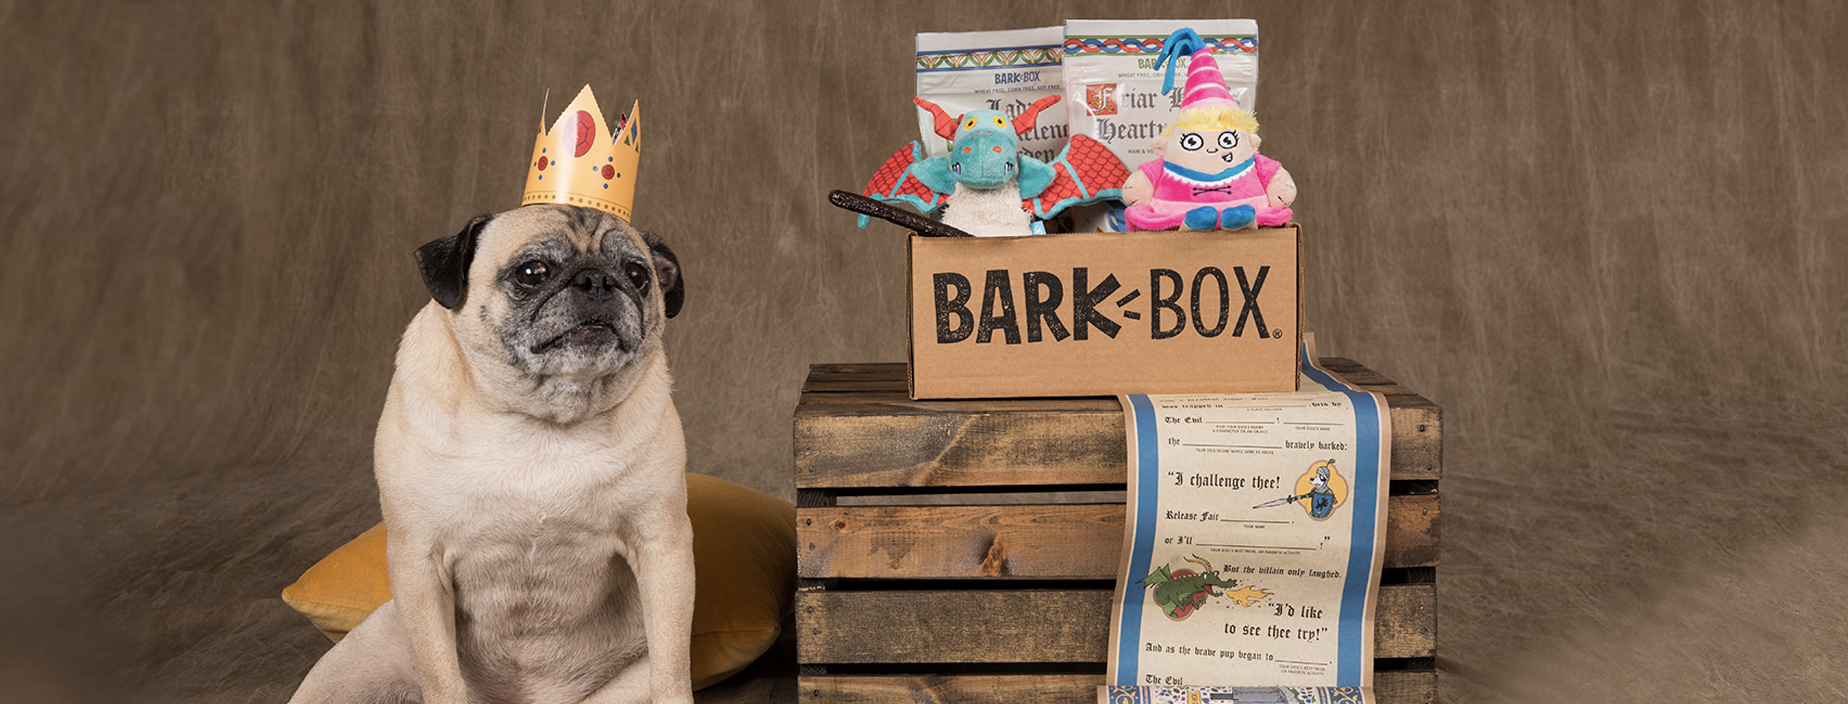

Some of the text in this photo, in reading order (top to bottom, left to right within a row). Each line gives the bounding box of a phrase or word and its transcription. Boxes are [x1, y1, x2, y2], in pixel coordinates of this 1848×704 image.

[933, 267, 1122, 344] BARK
[1164, 416, 1181, 425] The
[1184, 416, 1203, 424] Evil
[1168, 437, 1348, 451] the bravely barked:
[1190, 473, 1245, 490] challenge
[1252, 475, 1280, 491] thee!
[1166, 510, 1220, 522] Release Fair
[1223, 564, 1240, 573] But
[1243, 566, 1255, 574] the
[1258, 567, 1284, 575] villain
[1287, 568, 1305, 578] only
[1301, 605, 1323, 619] like
[1224, 623, 1236, 634] to
[1242, 624, 1261, 637] see
[1267, 625, 1291, 640] thee
[1145, 642, 1274, 661] And as the brave pup began to
[1145, 674, 1183, 686] The Evil
